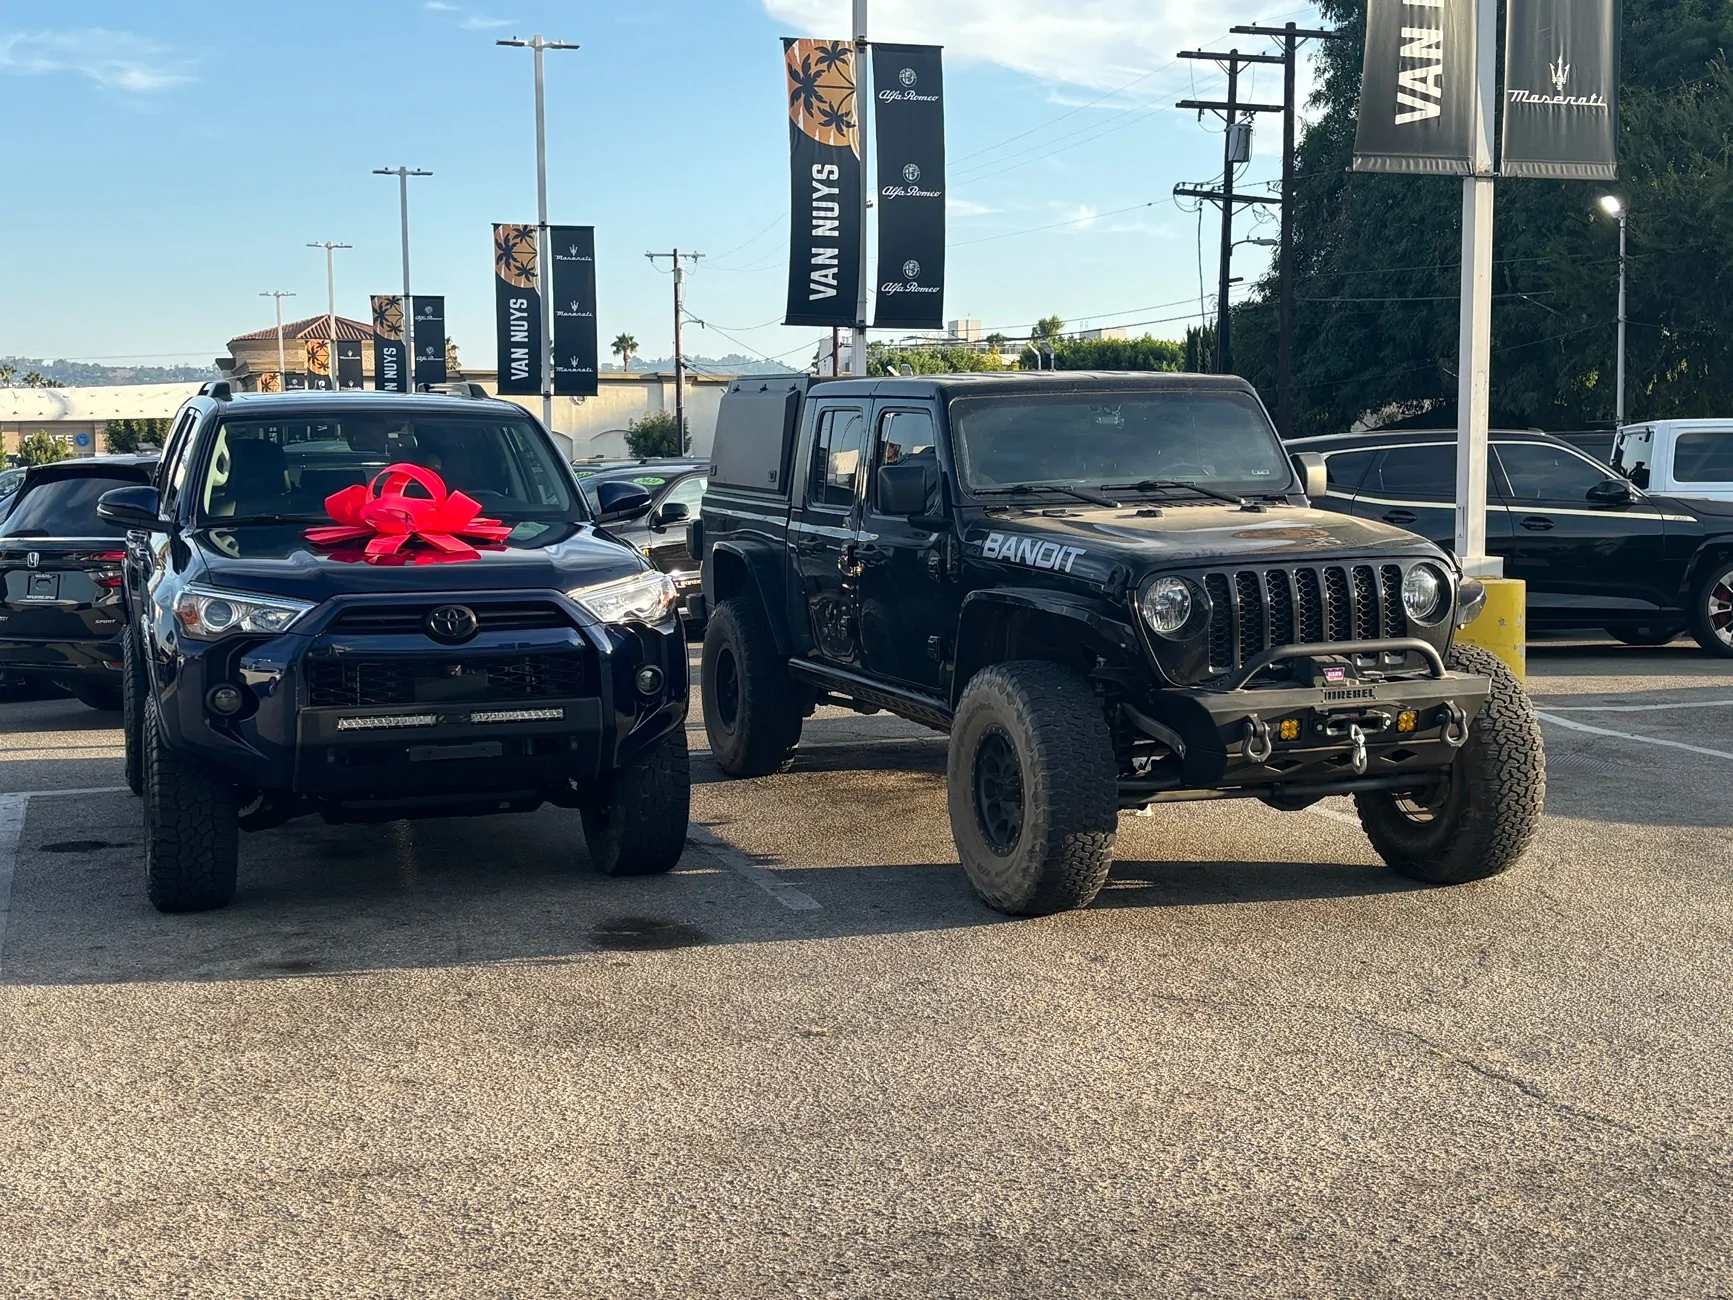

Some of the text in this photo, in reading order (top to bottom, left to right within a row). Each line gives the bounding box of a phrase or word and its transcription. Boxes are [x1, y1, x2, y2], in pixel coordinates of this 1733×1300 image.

[1395, 26, 1443, 125] VAN
[879, 89, 939, 104] Alfa Romeo
[1508, 89, 1608, 107] Maserati
[882, 185, 942, 200] Alfa Romeo
[809, 163, 840, 301] VAN NUYS
[881, 281, 940, 296] Alfa Romeo
[509, 298, 529, 380] VAN NUYS
[383, 347, 398, 379] NUYS
[982, 532, 1087, 573] BANDIT
